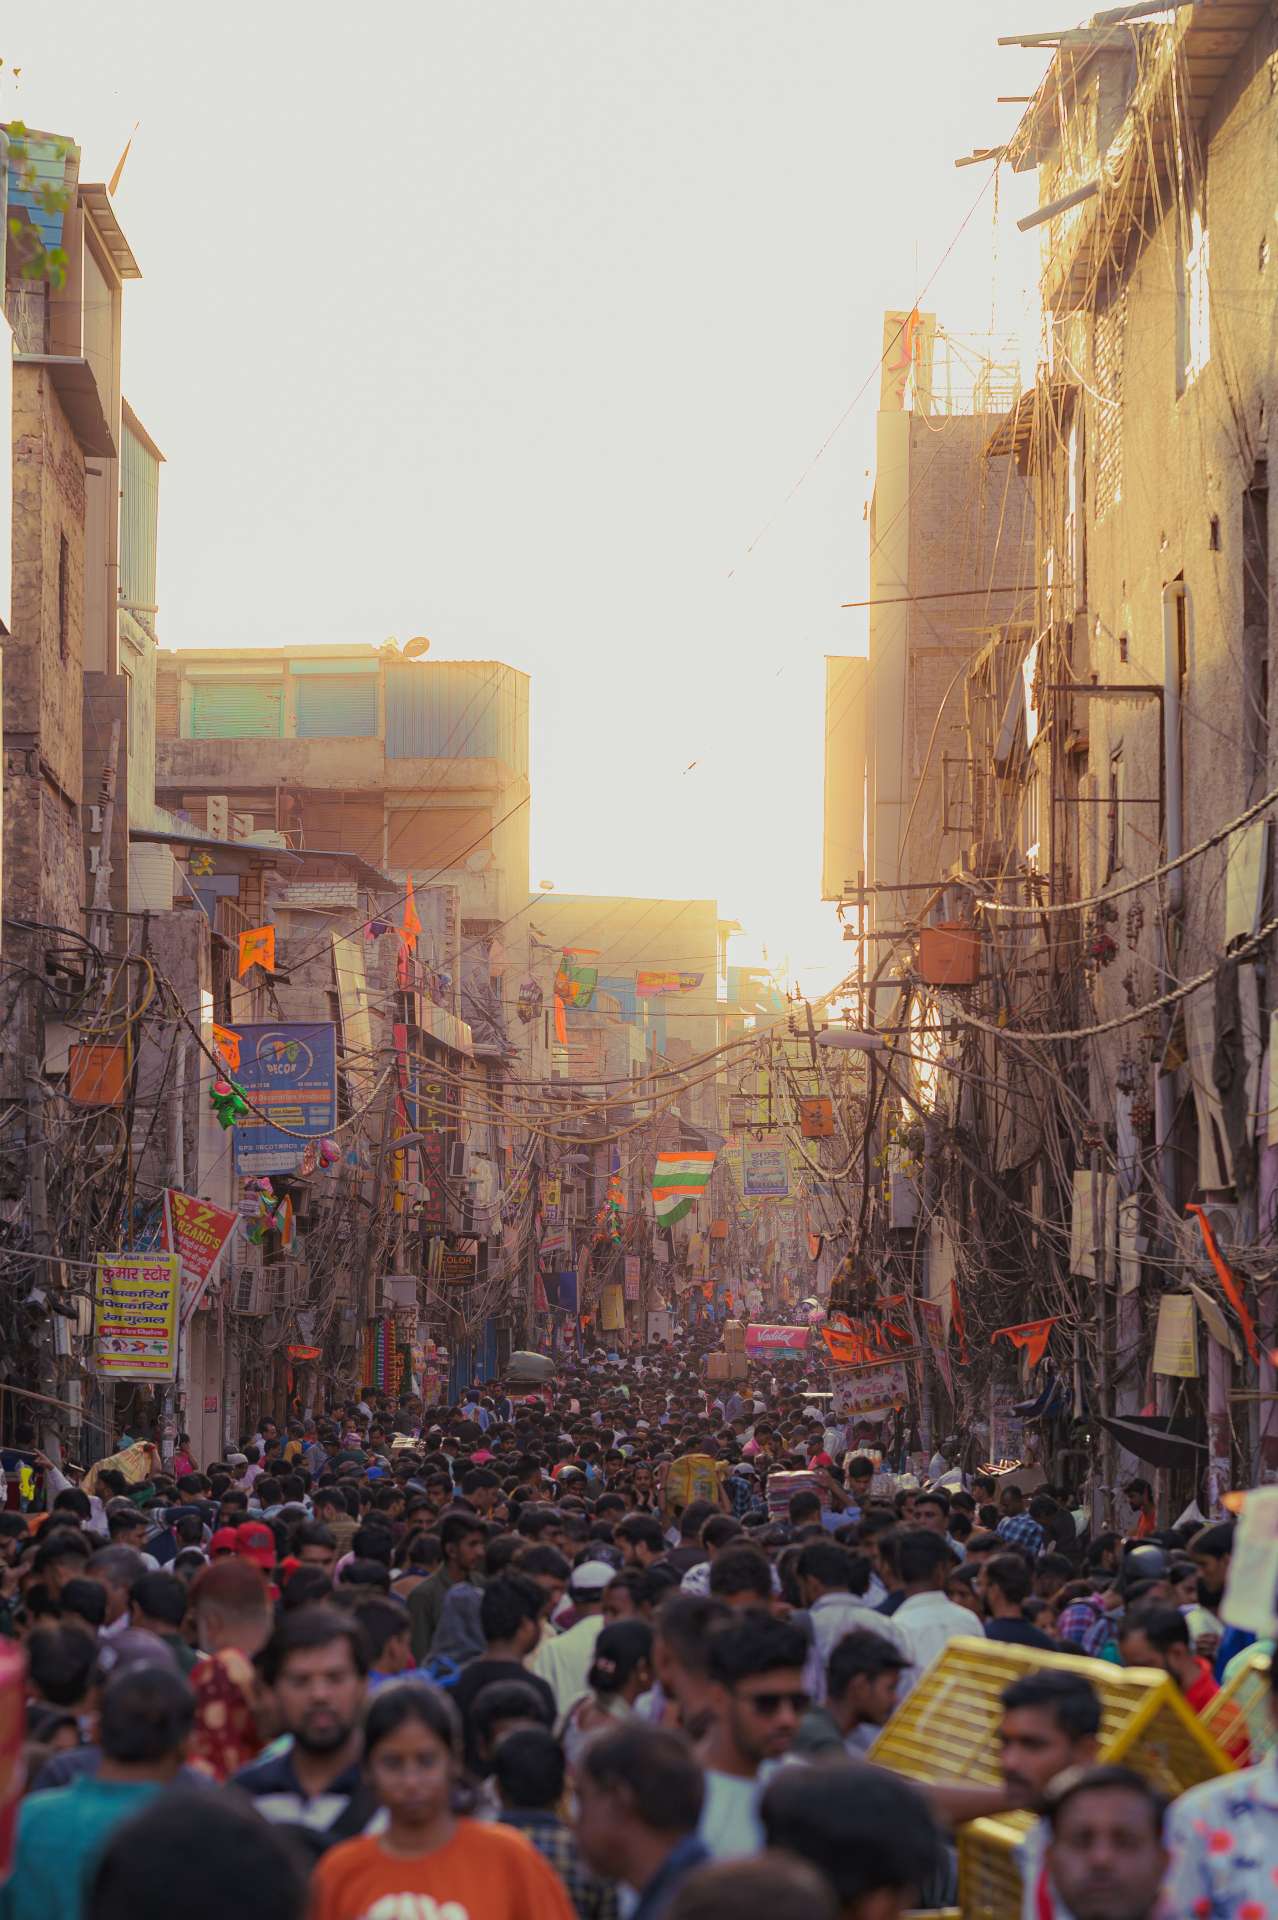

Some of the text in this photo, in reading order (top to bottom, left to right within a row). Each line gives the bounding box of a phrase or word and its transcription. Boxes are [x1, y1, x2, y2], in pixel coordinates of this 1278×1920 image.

[103, 1264, 170, 1283] कुमार स्टोर
[757, 1328, 794, 1346] Vadilal
